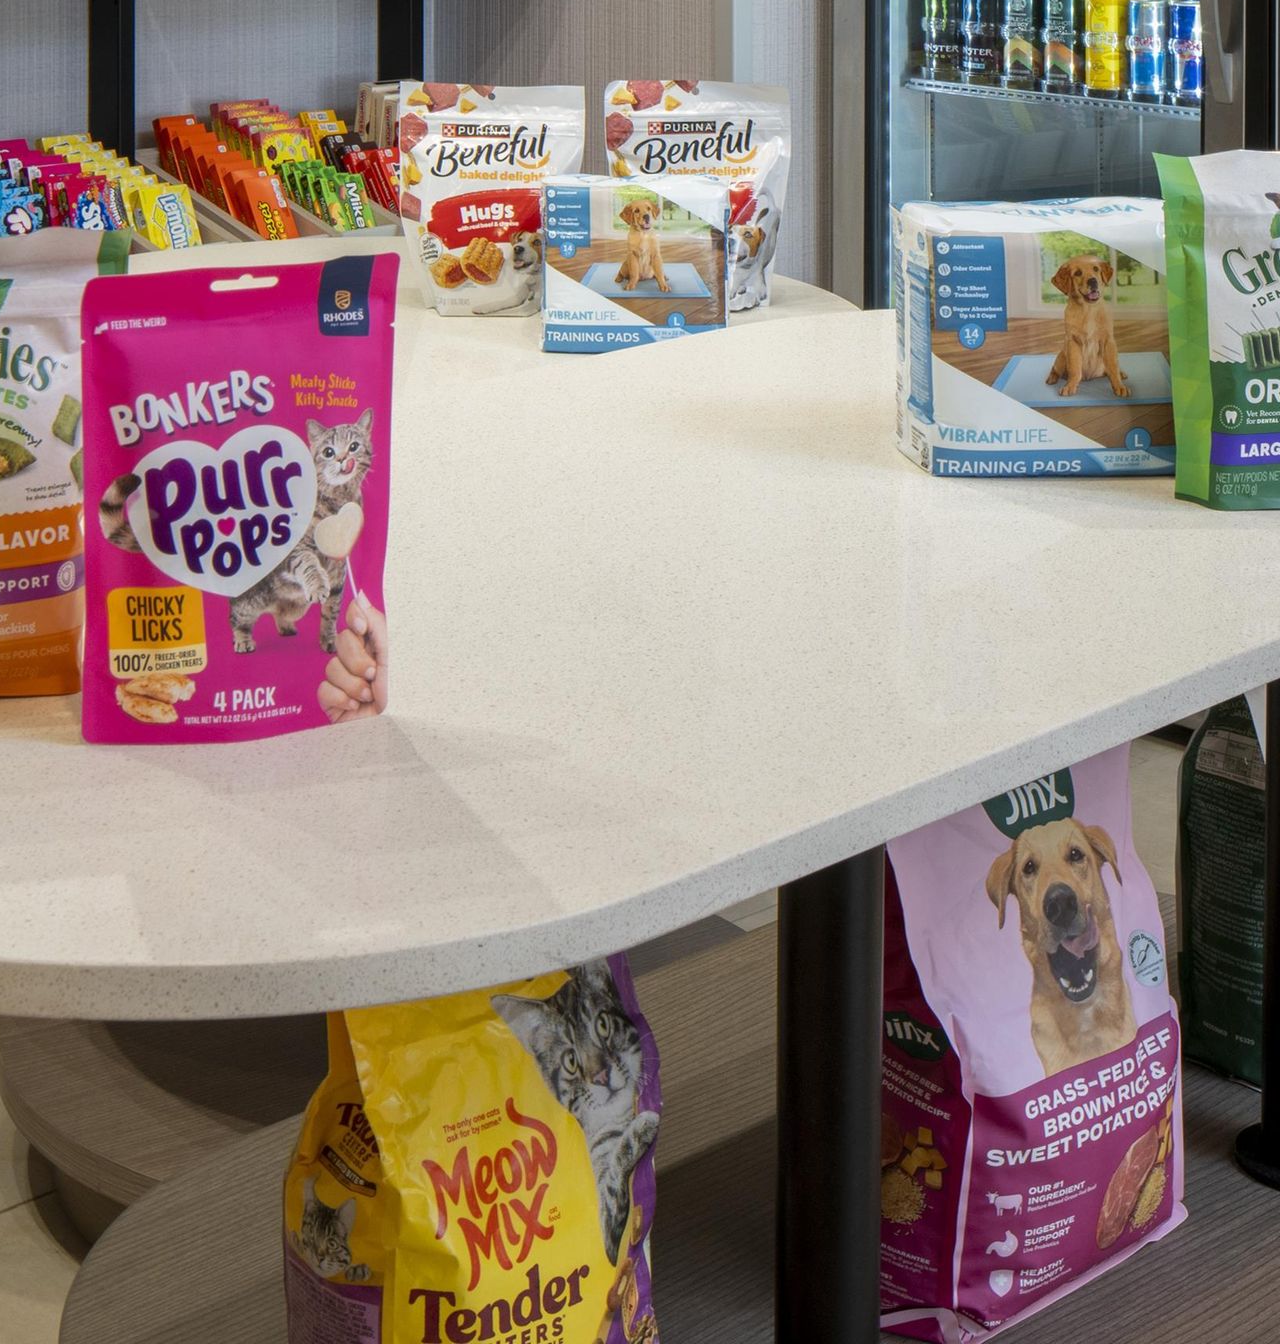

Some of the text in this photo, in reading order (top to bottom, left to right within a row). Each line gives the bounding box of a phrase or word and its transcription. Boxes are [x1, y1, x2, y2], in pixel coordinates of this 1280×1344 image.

[457, 124, 510, 138] PURINA
[663, 121, 716, 134] PURINA
[426, 123, 551, 178] Beneful
[633, 118, 755, 175] Beneful
[344, 181, 366, 229] Mike
[460, 202, 515, 224] Hugs
[110, 316, 167, 331] FEED THE WEIRD
[322, 311, 364, 324] RHODES
[547, 309, 618, 322] VIBRANT LIFE
[546, 330, 640, 344] TRAINING PADS
[964, 328, 980, 339] 14
[108, 369, 275, 447] BONKERS
[936, 427, 1049, 444] VIBRANT LIFE
[936, 458, 1082, 474] TRAINING PADS
[125, 594, 186, 616] CHICKY
[131, 618, 184, 643] LICKS
[113, 654, 153, 673] 100%
[213, 687, 276, 712] 4 PACK
[1005, 772, 1069, 826] Jinx
[1042, 1060, 1167, 1138] BROWN RICE &
[421, 1096, 558, 1241] Meow
[1027, 1180, 1086, 1206] INGREDIENT
[1028, 1180, 1064, 1195] OUR #1
[1023, 1226, 1071, 1247] SUPPORT
[1024, 1214, 1076, 1237] DIGESTIVE
[457, 1182, 555, 1292] Mix
[1019, 1264, 1065, 1288] IMMUNITY
[1020, 1257, 1065, 1277] HEALTHY
[408, 1263, 590, 1344] Tender
